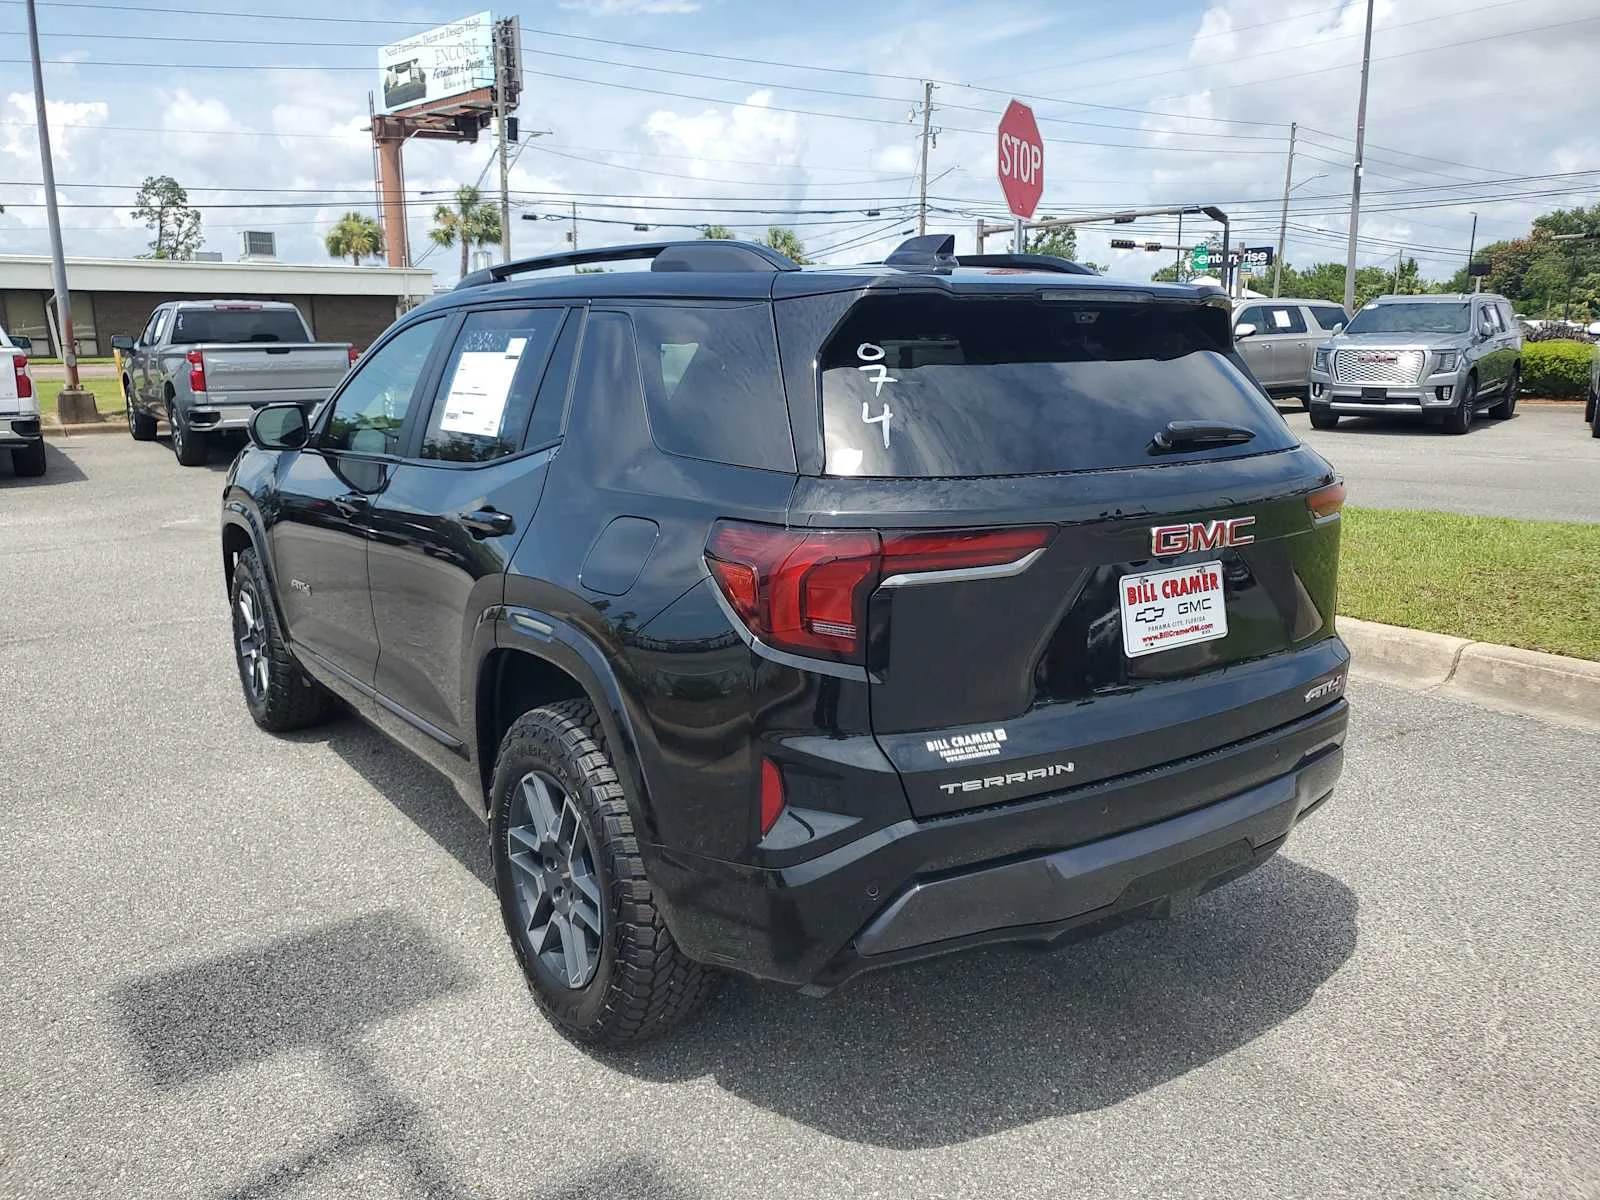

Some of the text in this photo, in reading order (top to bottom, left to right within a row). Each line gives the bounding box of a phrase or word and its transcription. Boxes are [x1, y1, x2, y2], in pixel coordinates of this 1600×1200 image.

[435, 38, 479, 66] ENCORE
[1001, 132, 1041, 186] STOP
[857, 342, 898, 449] 074
[1151, 515, 1256, 556] GMC
[1127, 572, 1219, 606] BILL CRAMER
[1177, 598, 1212, 615] GMC
[1142, 623, 1214, 643] www.BillCramerGM.com
[1147, 622, 1171, 632] PANAMA
[1185, 615, 1206, 625] FLORIDA
[926, 738, 949, 752] BILL
[951, 731, 995, 748] CRAMER
[939, 762, 1075, 794] TERRAIN
